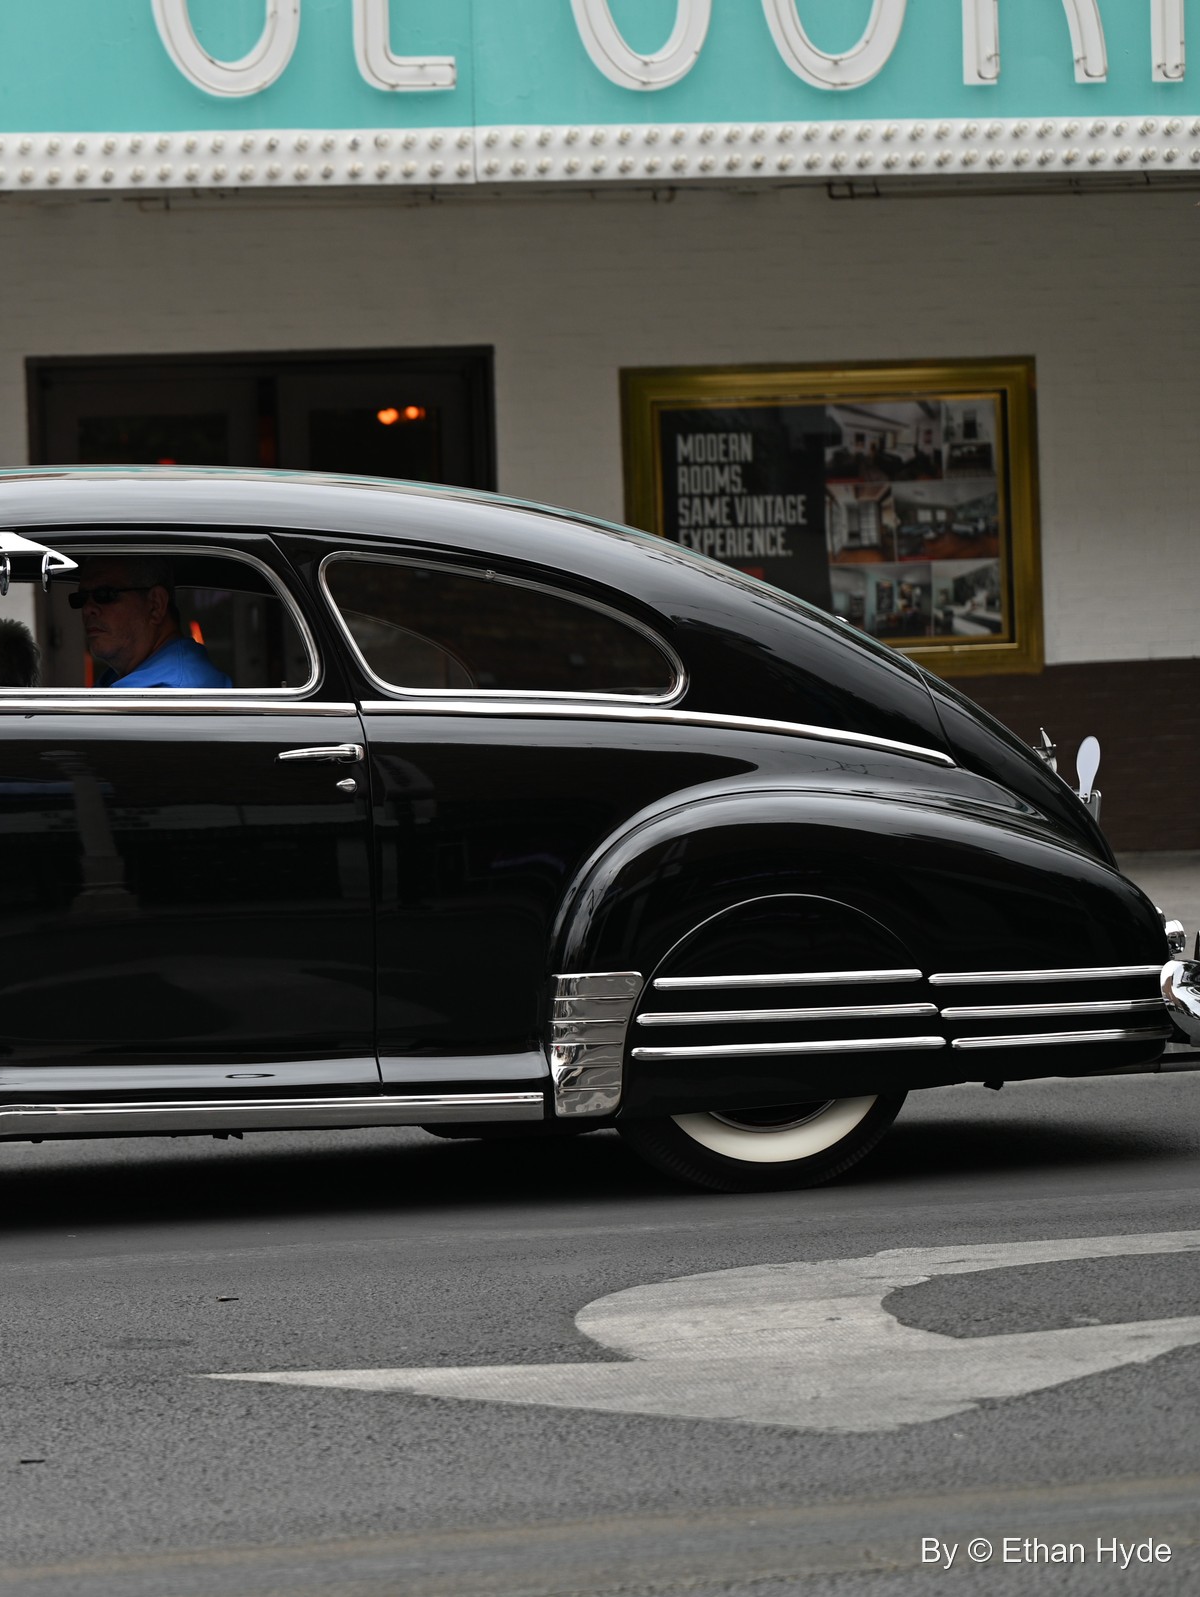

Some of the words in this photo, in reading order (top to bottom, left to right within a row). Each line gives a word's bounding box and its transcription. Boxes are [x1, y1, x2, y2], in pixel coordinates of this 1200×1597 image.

[677, 433, 753, 463] MODERN
[678, 465, 747, 494] ROOMS.
[678, 498, 731, 526] SAME
[735, 494, 807, 525] VINTAGE
[679, 527, 793, 558] EXPERIENCE.
